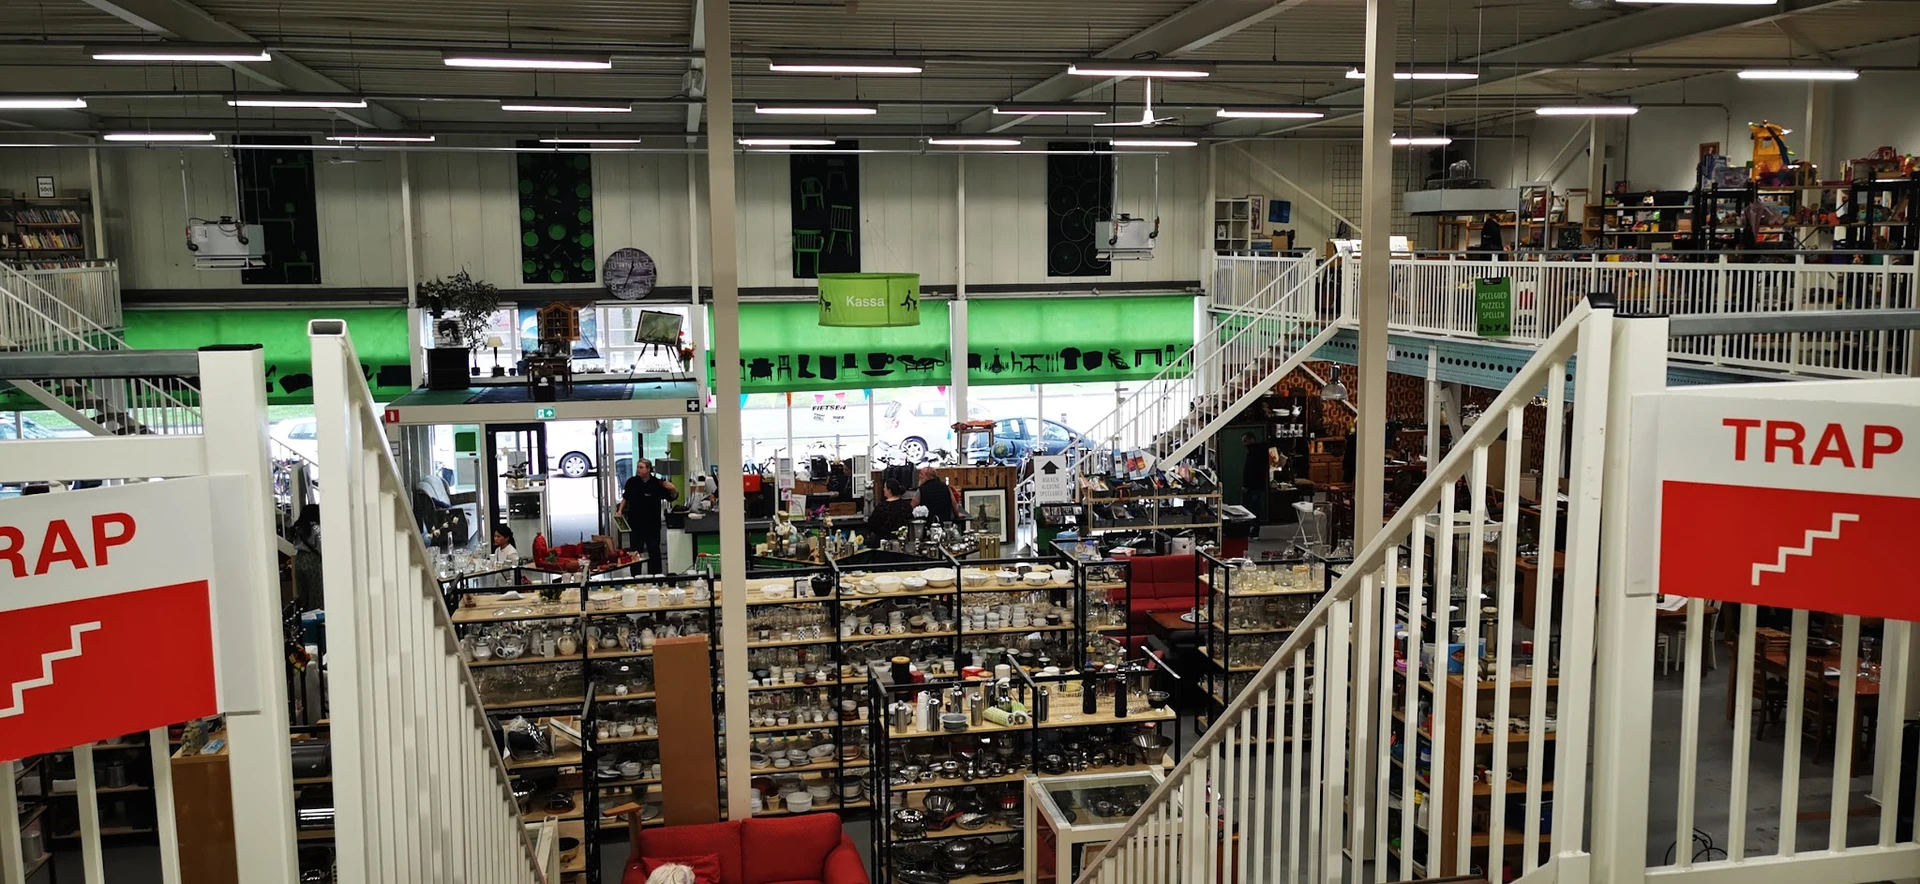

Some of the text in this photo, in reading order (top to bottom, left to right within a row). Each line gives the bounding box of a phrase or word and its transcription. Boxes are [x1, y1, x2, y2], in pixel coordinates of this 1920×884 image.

[846, 295, 885, 307] Kassa
[1478, 292, 1508, 300] SPEELGOED
[1482, 311, 1505, 319] SPELLEN
[1722, 418, 1904, 469] TRAP
